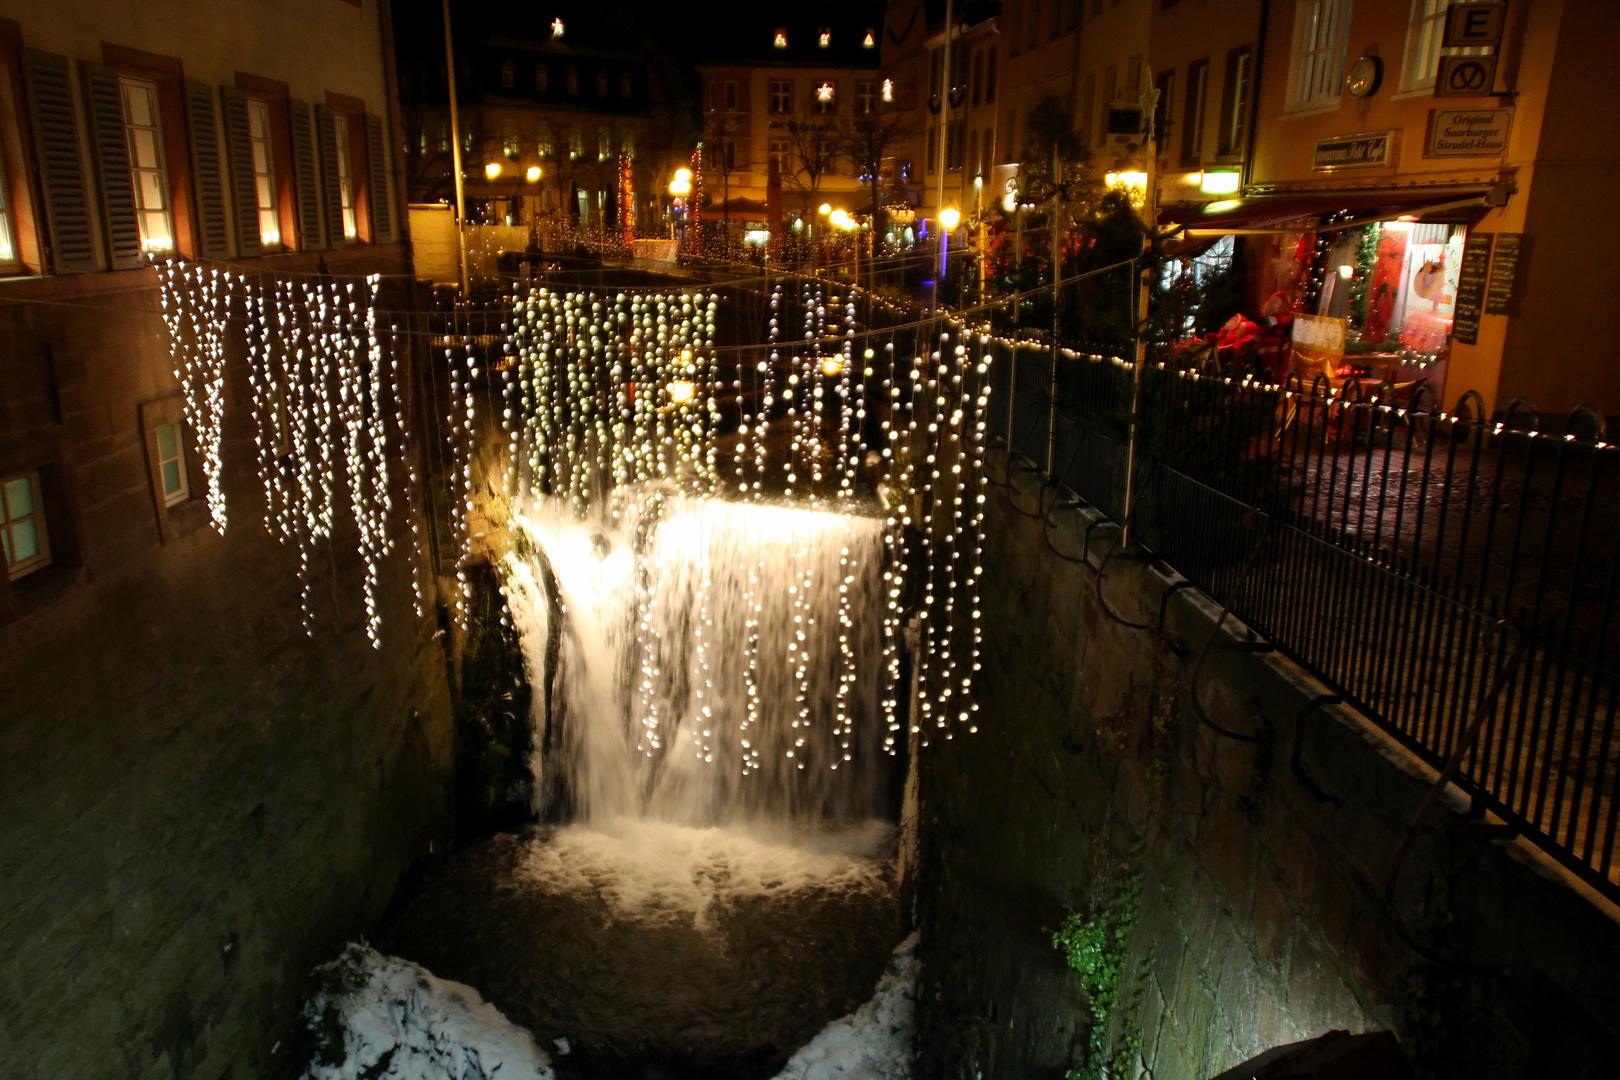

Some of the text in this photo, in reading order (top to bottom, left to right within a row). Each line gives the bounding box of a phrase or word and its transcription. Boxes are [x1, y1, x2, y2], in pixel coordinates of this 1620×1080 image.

[1464, 10, 1490, 37] E
[1453, 114, 1494, 126] Original
[1444, 127, 1500, 139] Saarburger
[1437, 139, 1503, 150] Strudel-Haus
